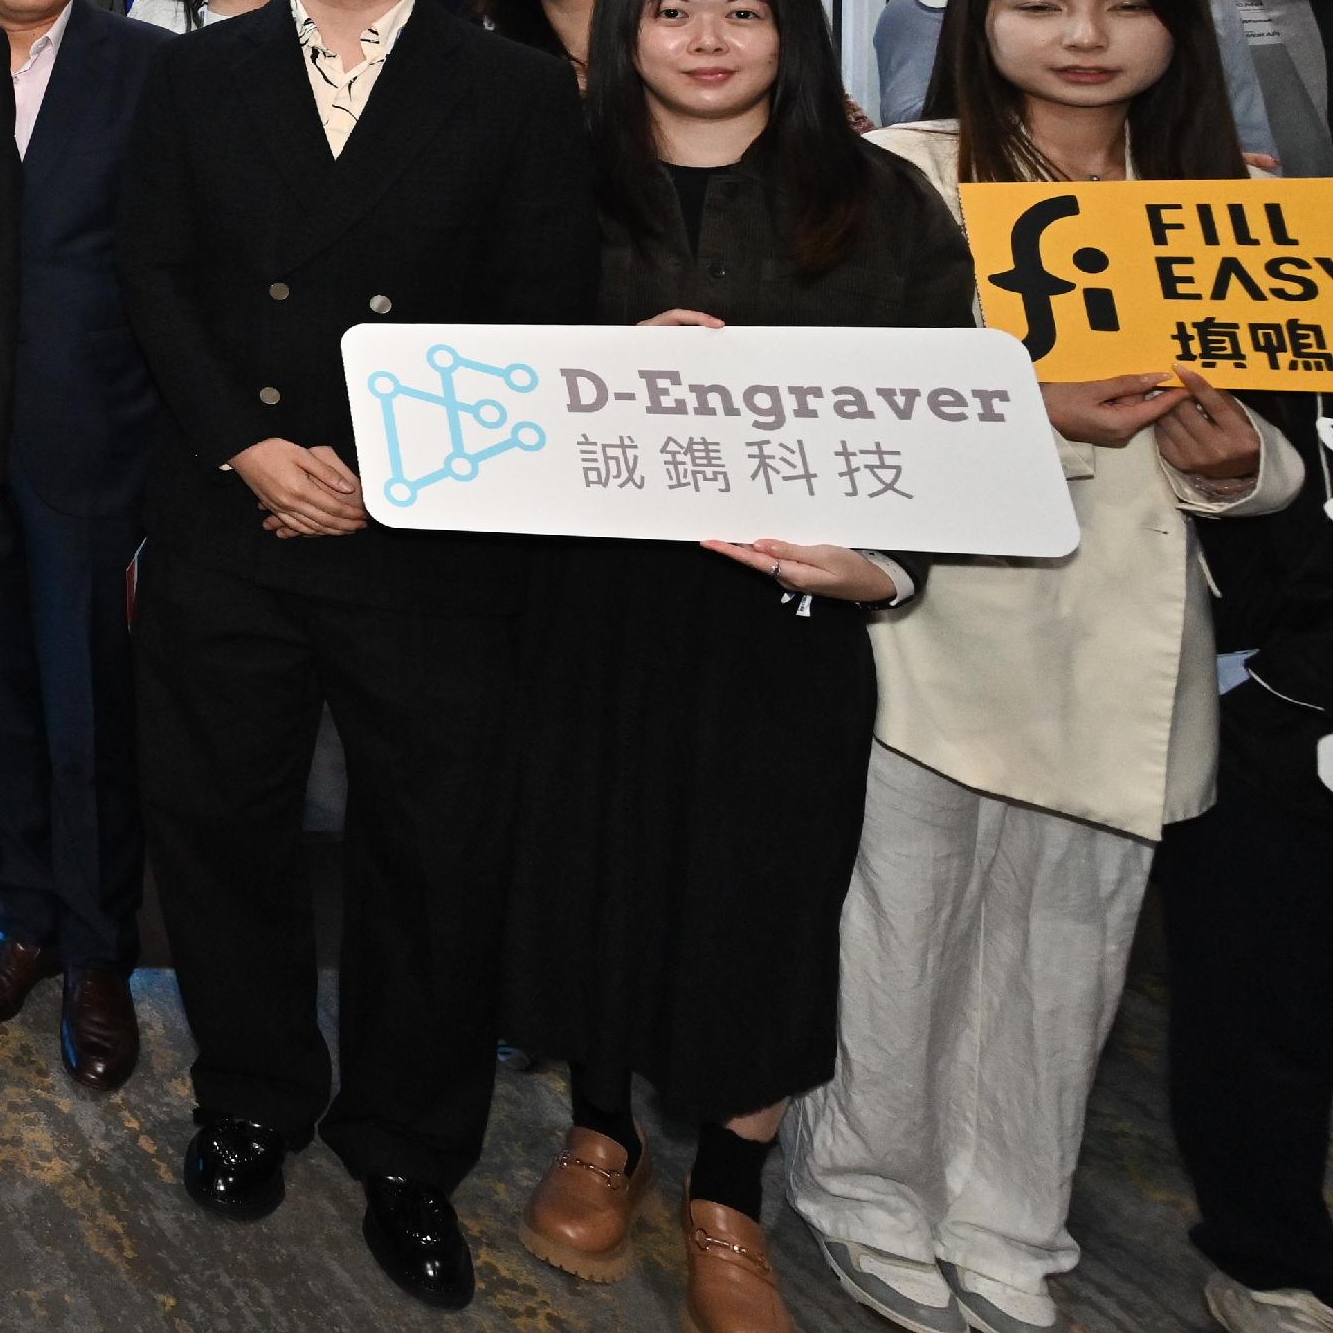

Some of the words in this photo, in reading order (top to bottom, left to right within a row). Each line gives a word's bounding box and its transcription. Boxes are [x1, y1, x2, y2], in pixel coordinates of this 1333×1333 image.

[1145, 203, 1300, 246] FILL
[1171, 317, 1333, 372] 填鴨
[560, 367, 1012, 431] D-Engraver
